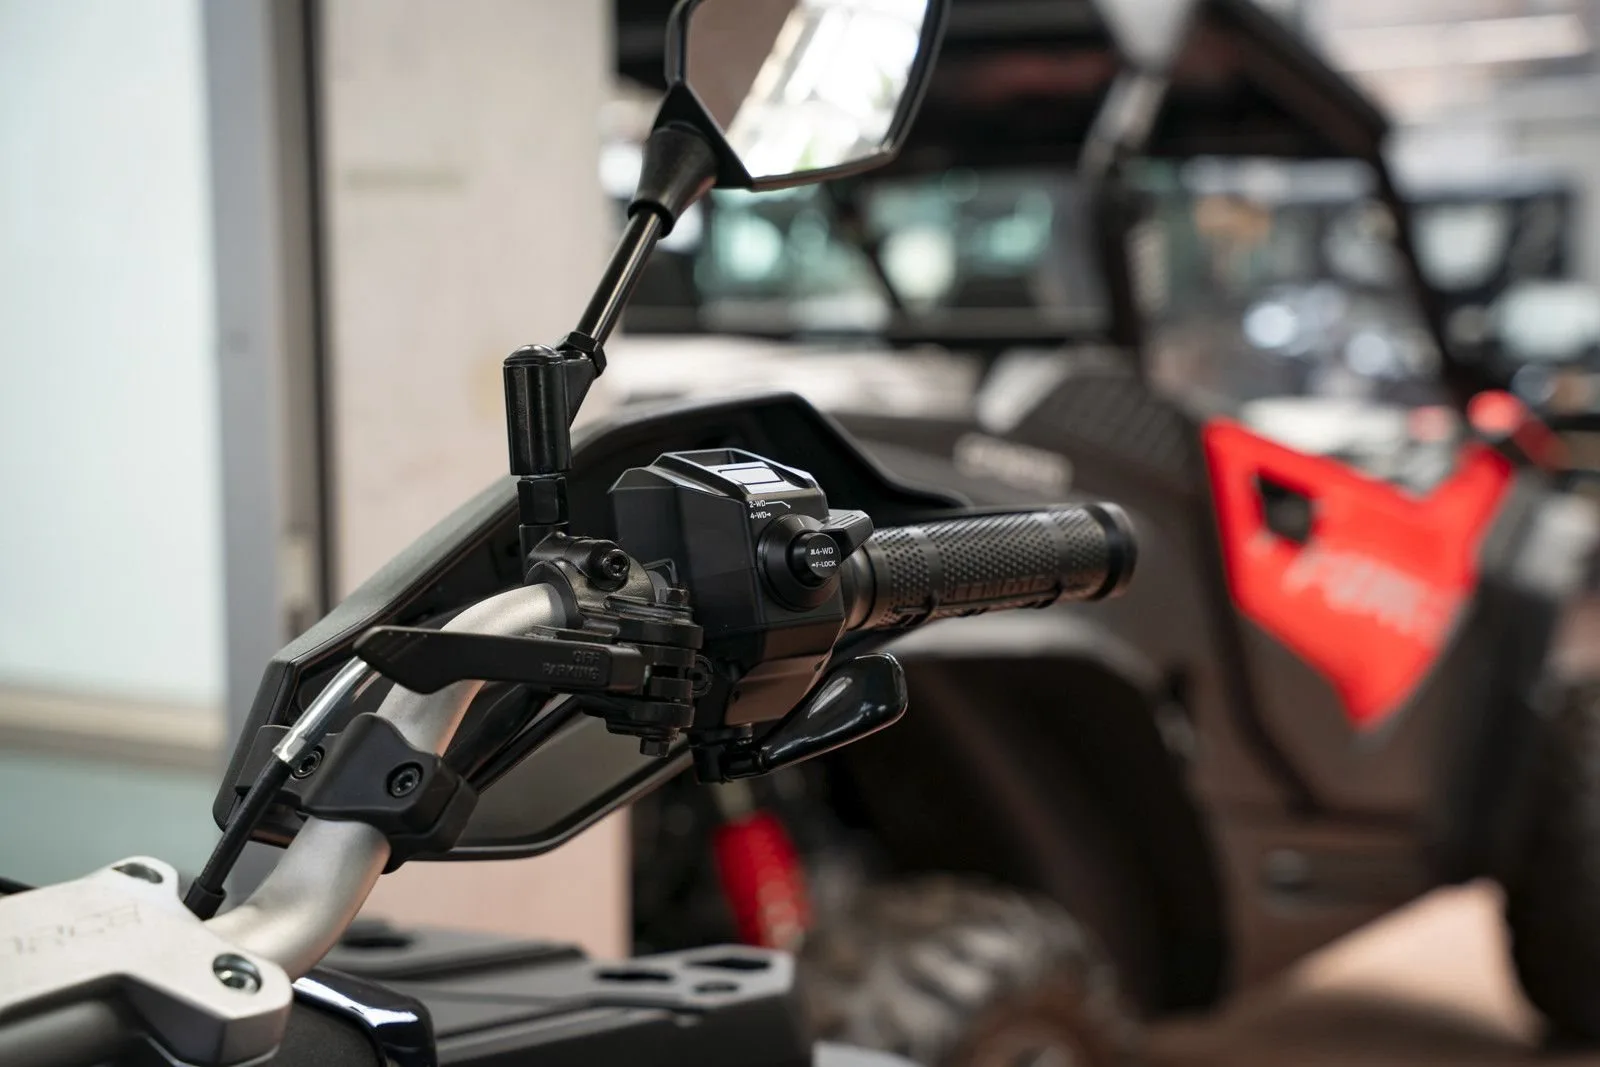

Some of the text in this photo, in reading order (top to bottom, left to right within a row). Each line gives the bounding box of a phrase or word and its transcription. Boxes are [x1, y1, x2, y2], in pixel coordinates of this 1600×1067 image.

[749, 500, 766, 508] 2-WD
[750, 511, 767, 519] 4-WD
[815, 560, 836, 568] F-LOCK
